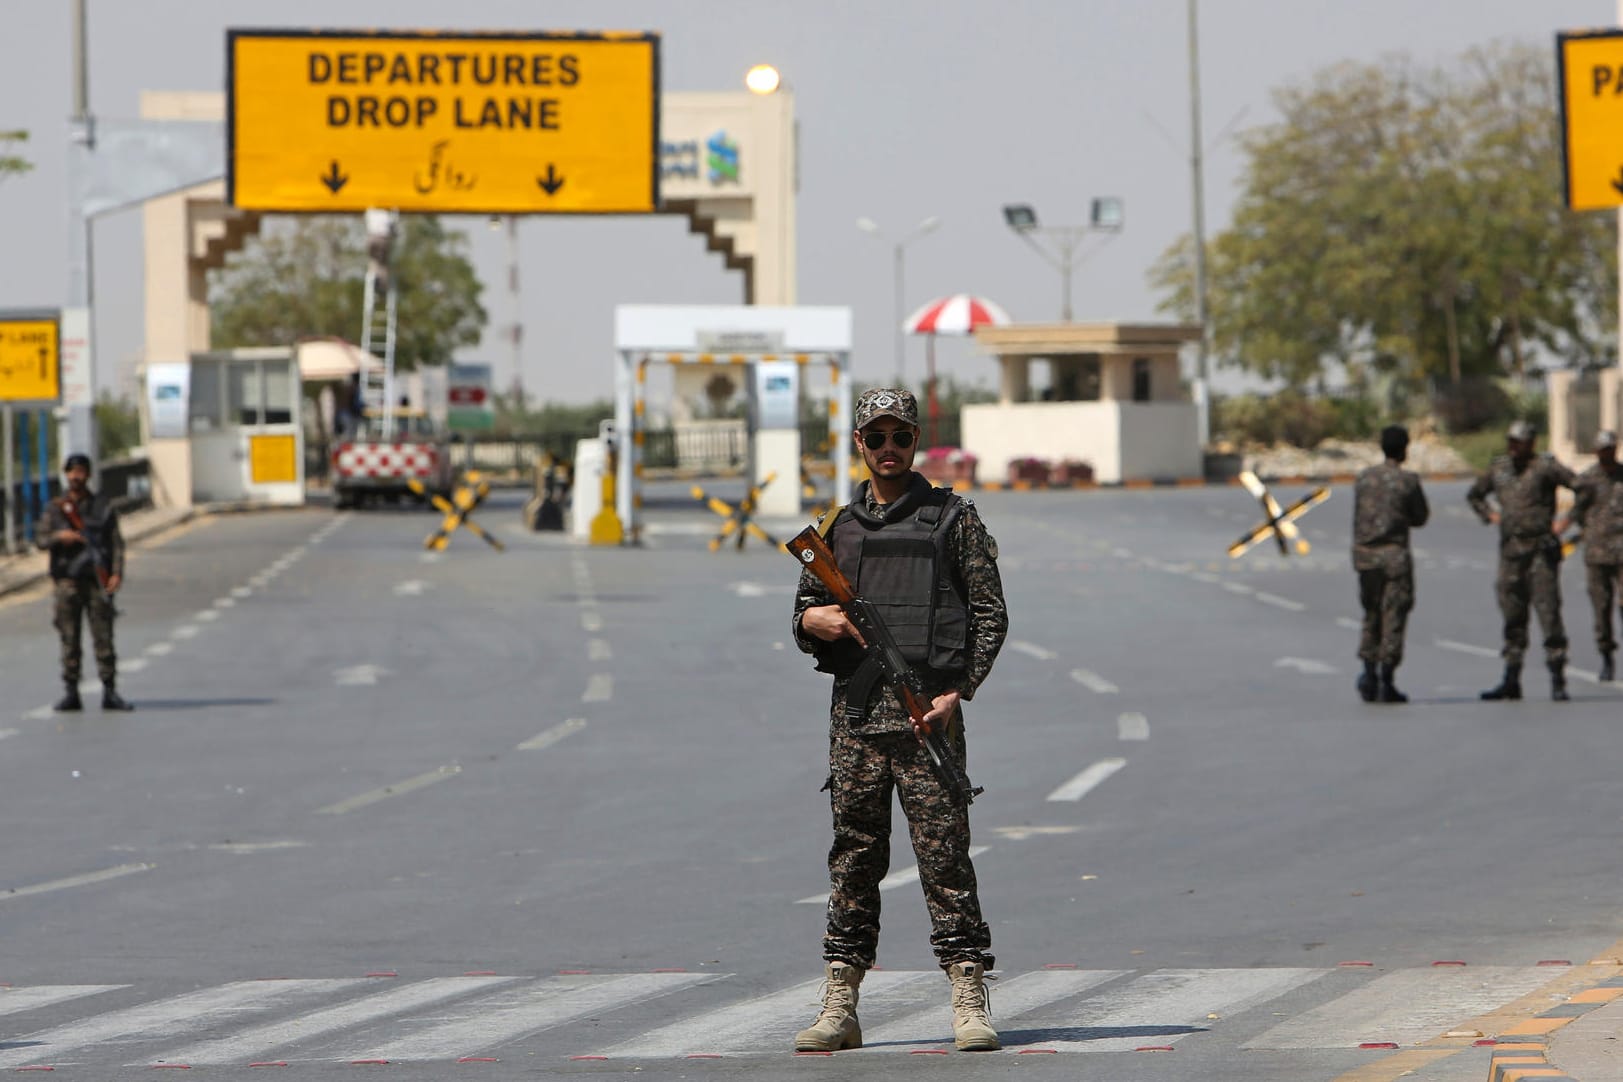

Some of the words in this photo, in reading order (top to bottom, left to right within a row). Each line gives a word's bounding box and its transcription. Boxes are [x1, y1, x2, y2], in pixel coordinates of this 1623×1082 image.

[308, 53, 579, 87] DEPARTURES
[327, 96, 437, 130] DROP
[454, 97, 561, 131] LANE
